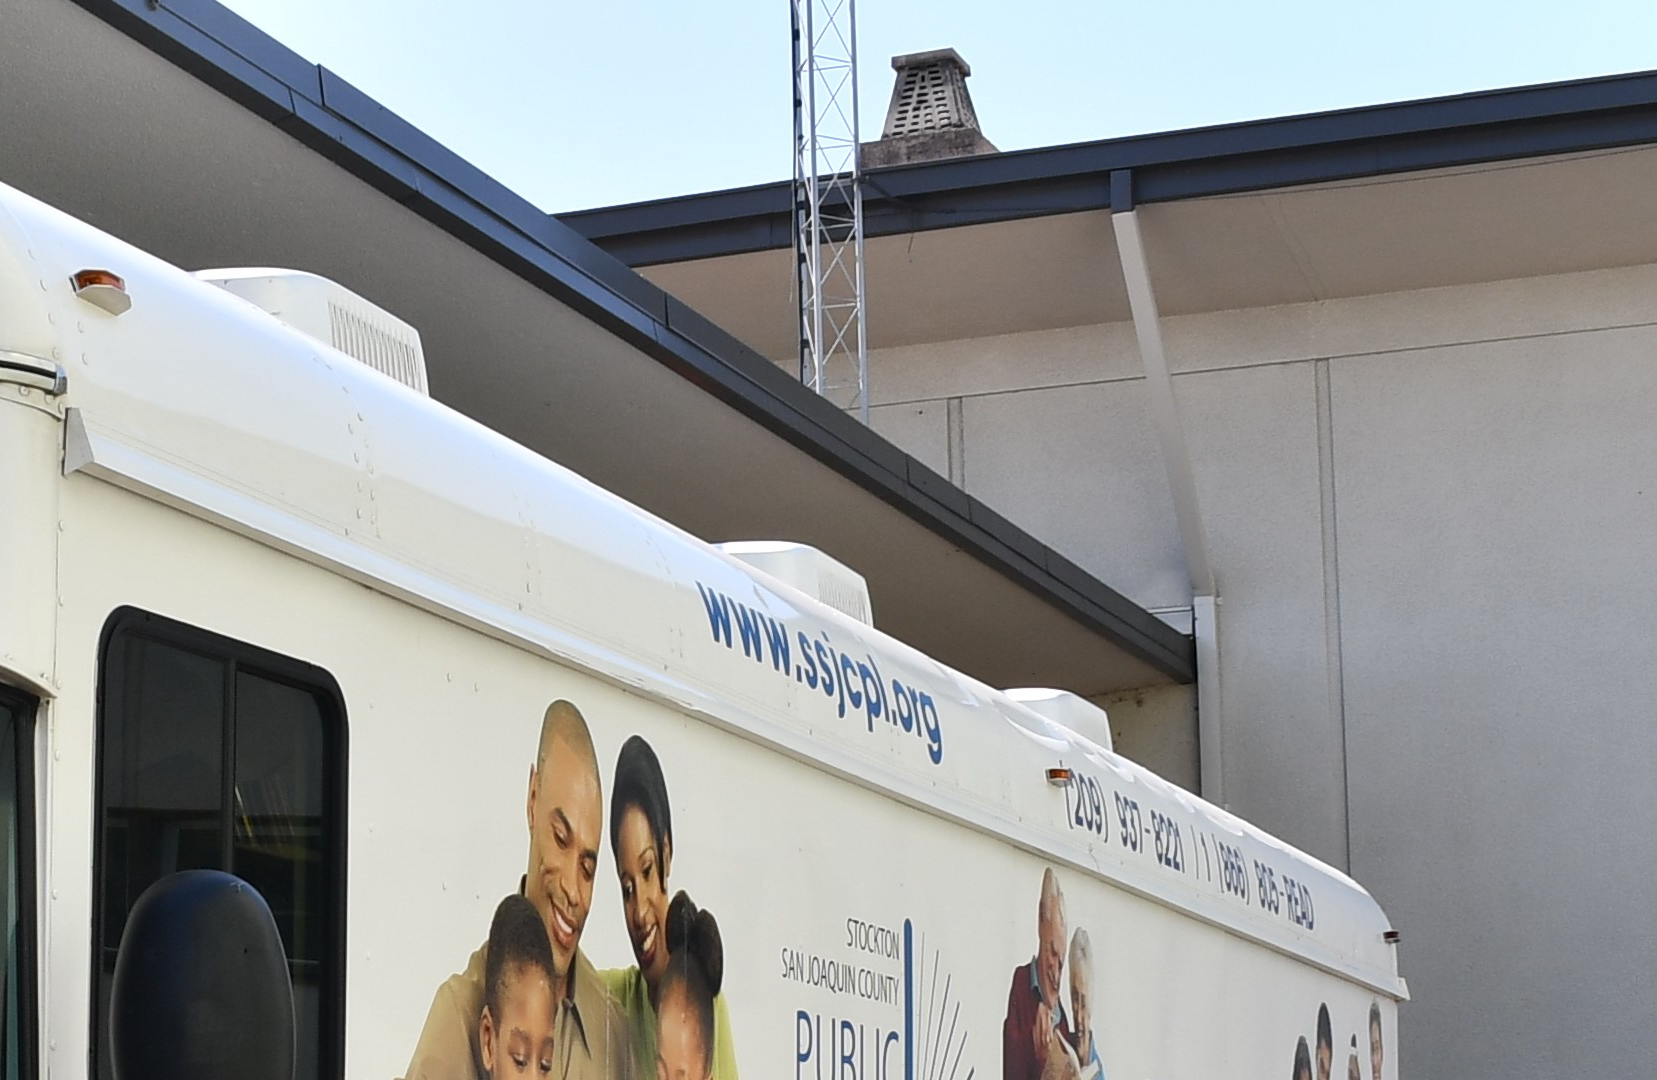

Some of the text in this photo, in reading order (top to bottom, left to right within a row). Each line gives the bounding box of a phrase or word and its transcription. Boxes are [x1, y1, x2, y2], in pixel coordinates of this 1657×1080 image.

[695, 580, 943, 765] www.ssjcpl.org
[1059, 760, 1109, 844] (209)
[1114, 790, 1185, 874] 937-8221
[1211, 833, 1250, 906] (866)
[1253, 859, 1315, 931] 805-READ
[781, 947, 900, 1006] SAN JOAQUIN COUNTY
[846, 917, 900, 960] STOCKTON
